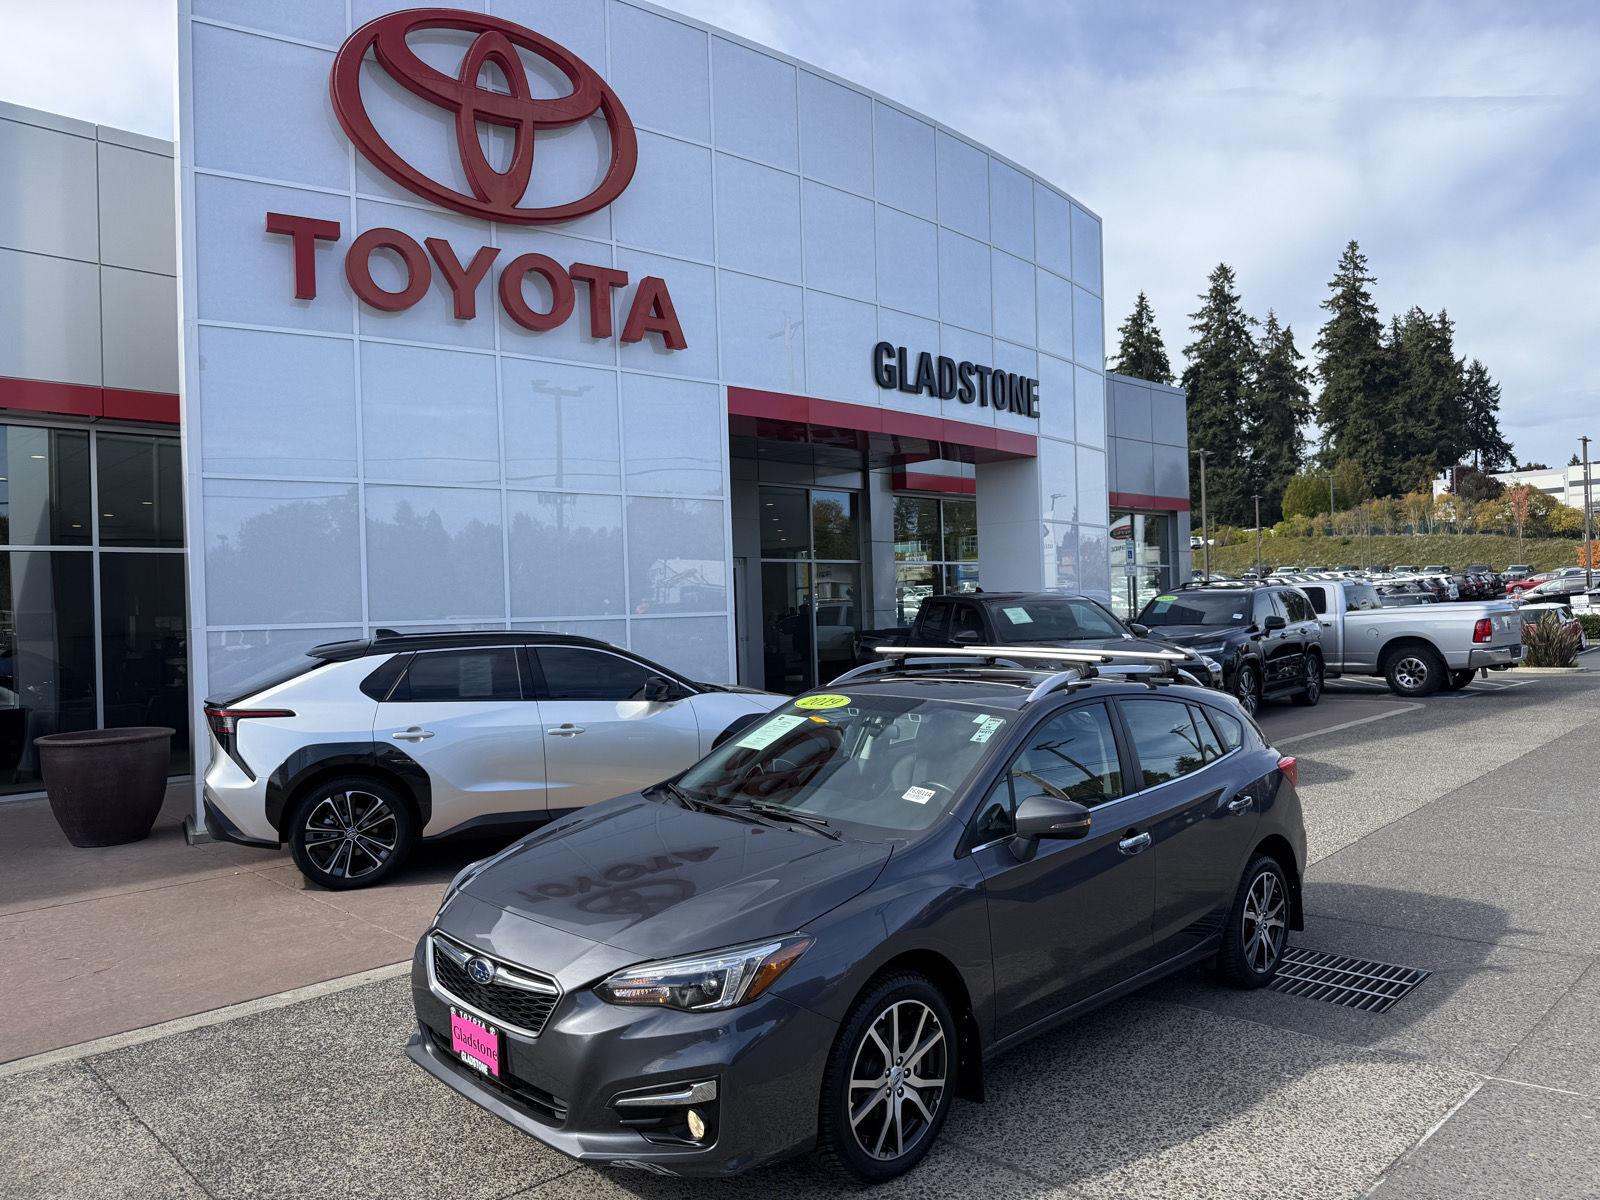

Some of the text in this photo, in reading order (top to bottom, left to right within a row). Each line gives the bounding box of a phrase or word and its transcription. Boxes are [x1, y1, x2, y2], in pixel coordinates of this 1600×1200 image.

[266, 211, 688, 351] TOYOTA
[874, 341, 1041, 419] GLADSTONE
[800, 696, 845, 707] 2019
[459, 1010, 487, 1030] TOYOTA
[453, 1025, 498, 1062] Gladstone
[460, 1051, 489, 1076] GLADSTONE
